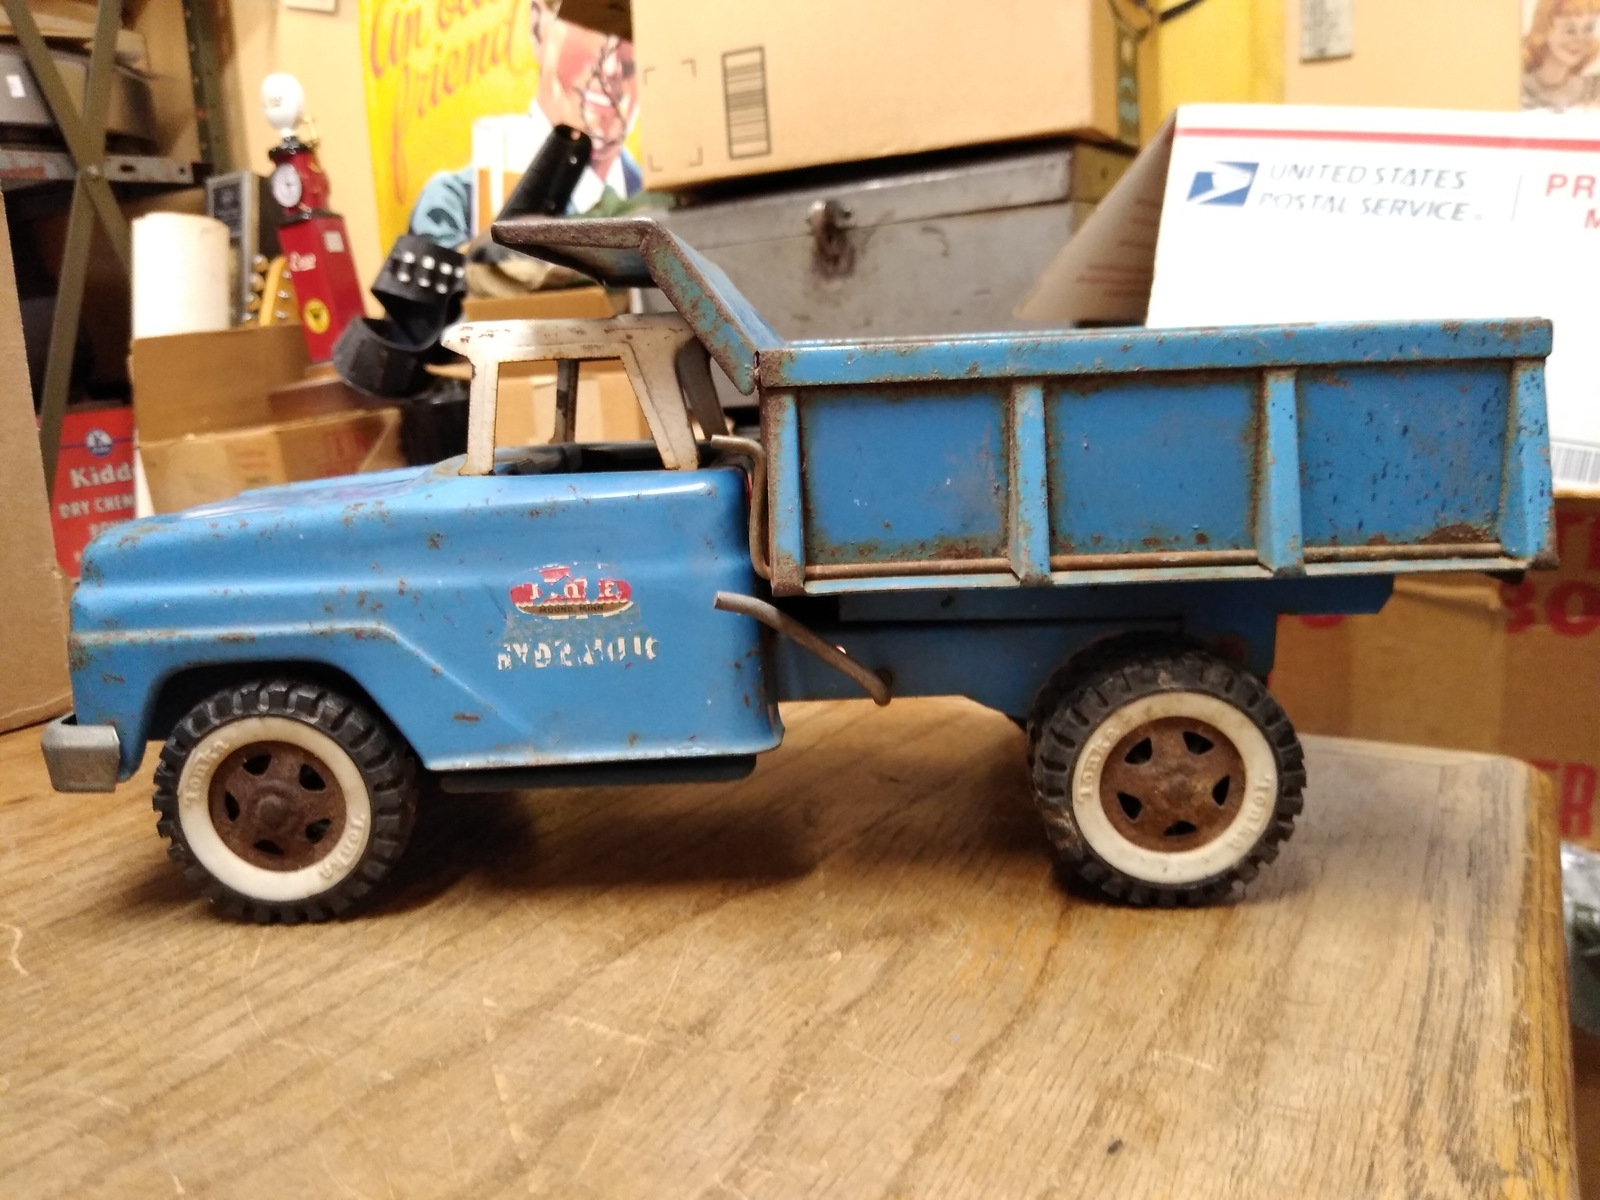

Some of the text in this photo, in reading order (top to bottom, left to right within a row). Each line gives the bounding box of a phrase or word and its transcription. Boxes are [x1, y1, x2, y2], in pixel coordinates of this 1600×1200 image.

[1270, 163, 1468, 190] UNITED STATES
[1257, 192, 1471, 222] POSTAL SERVICE
[58, 499, 90, 519] DRY
[319, 812, 367, 882] Tonka
